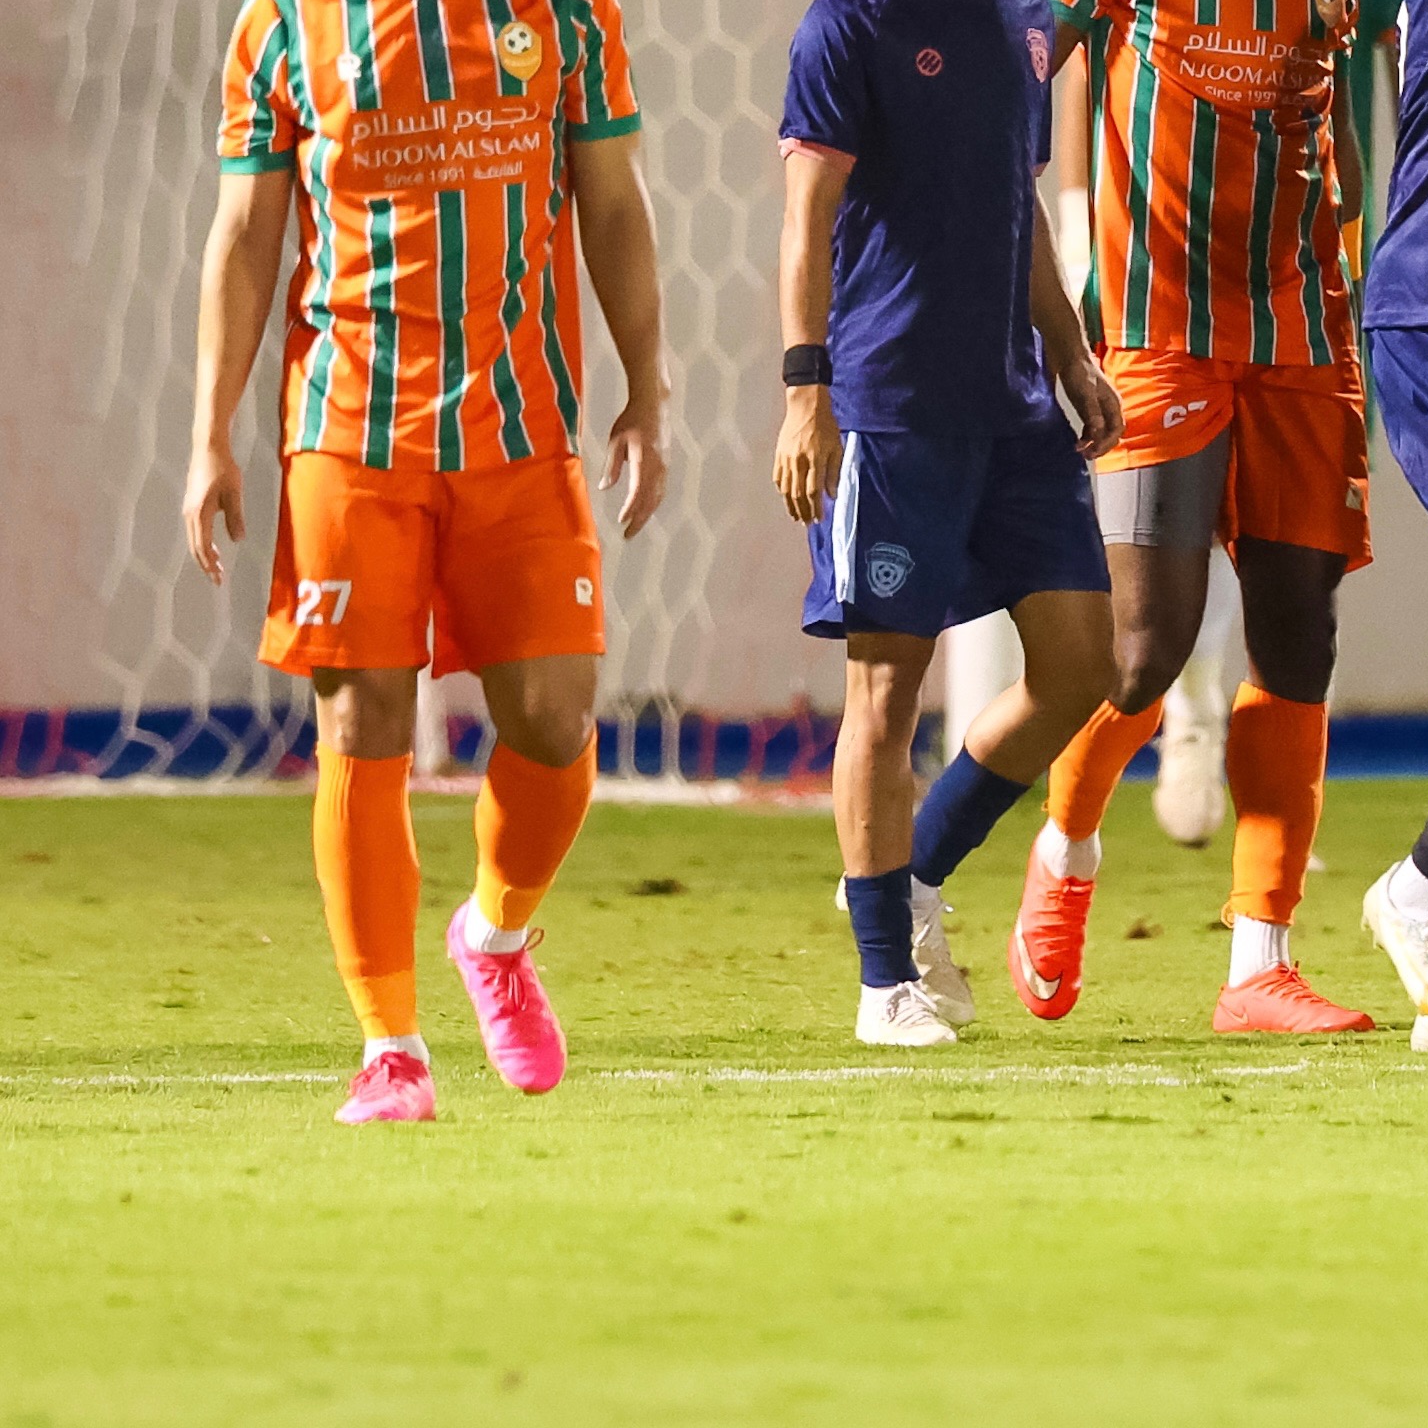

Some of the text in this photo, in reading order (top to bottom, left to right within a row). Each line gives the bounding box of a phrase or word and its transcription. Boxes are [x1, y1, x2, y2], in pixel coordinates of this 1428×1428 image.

[1183, 31, 1267, 57] السلام
[1179, 59, 1263, 85] NJOOM
[351, 104, 447, 147] السلام
[351, 131, 541, 170] NJOOM ALSLAM
[429, 165, 466, 184] 1991
[295, 578, 352, 626] 27
